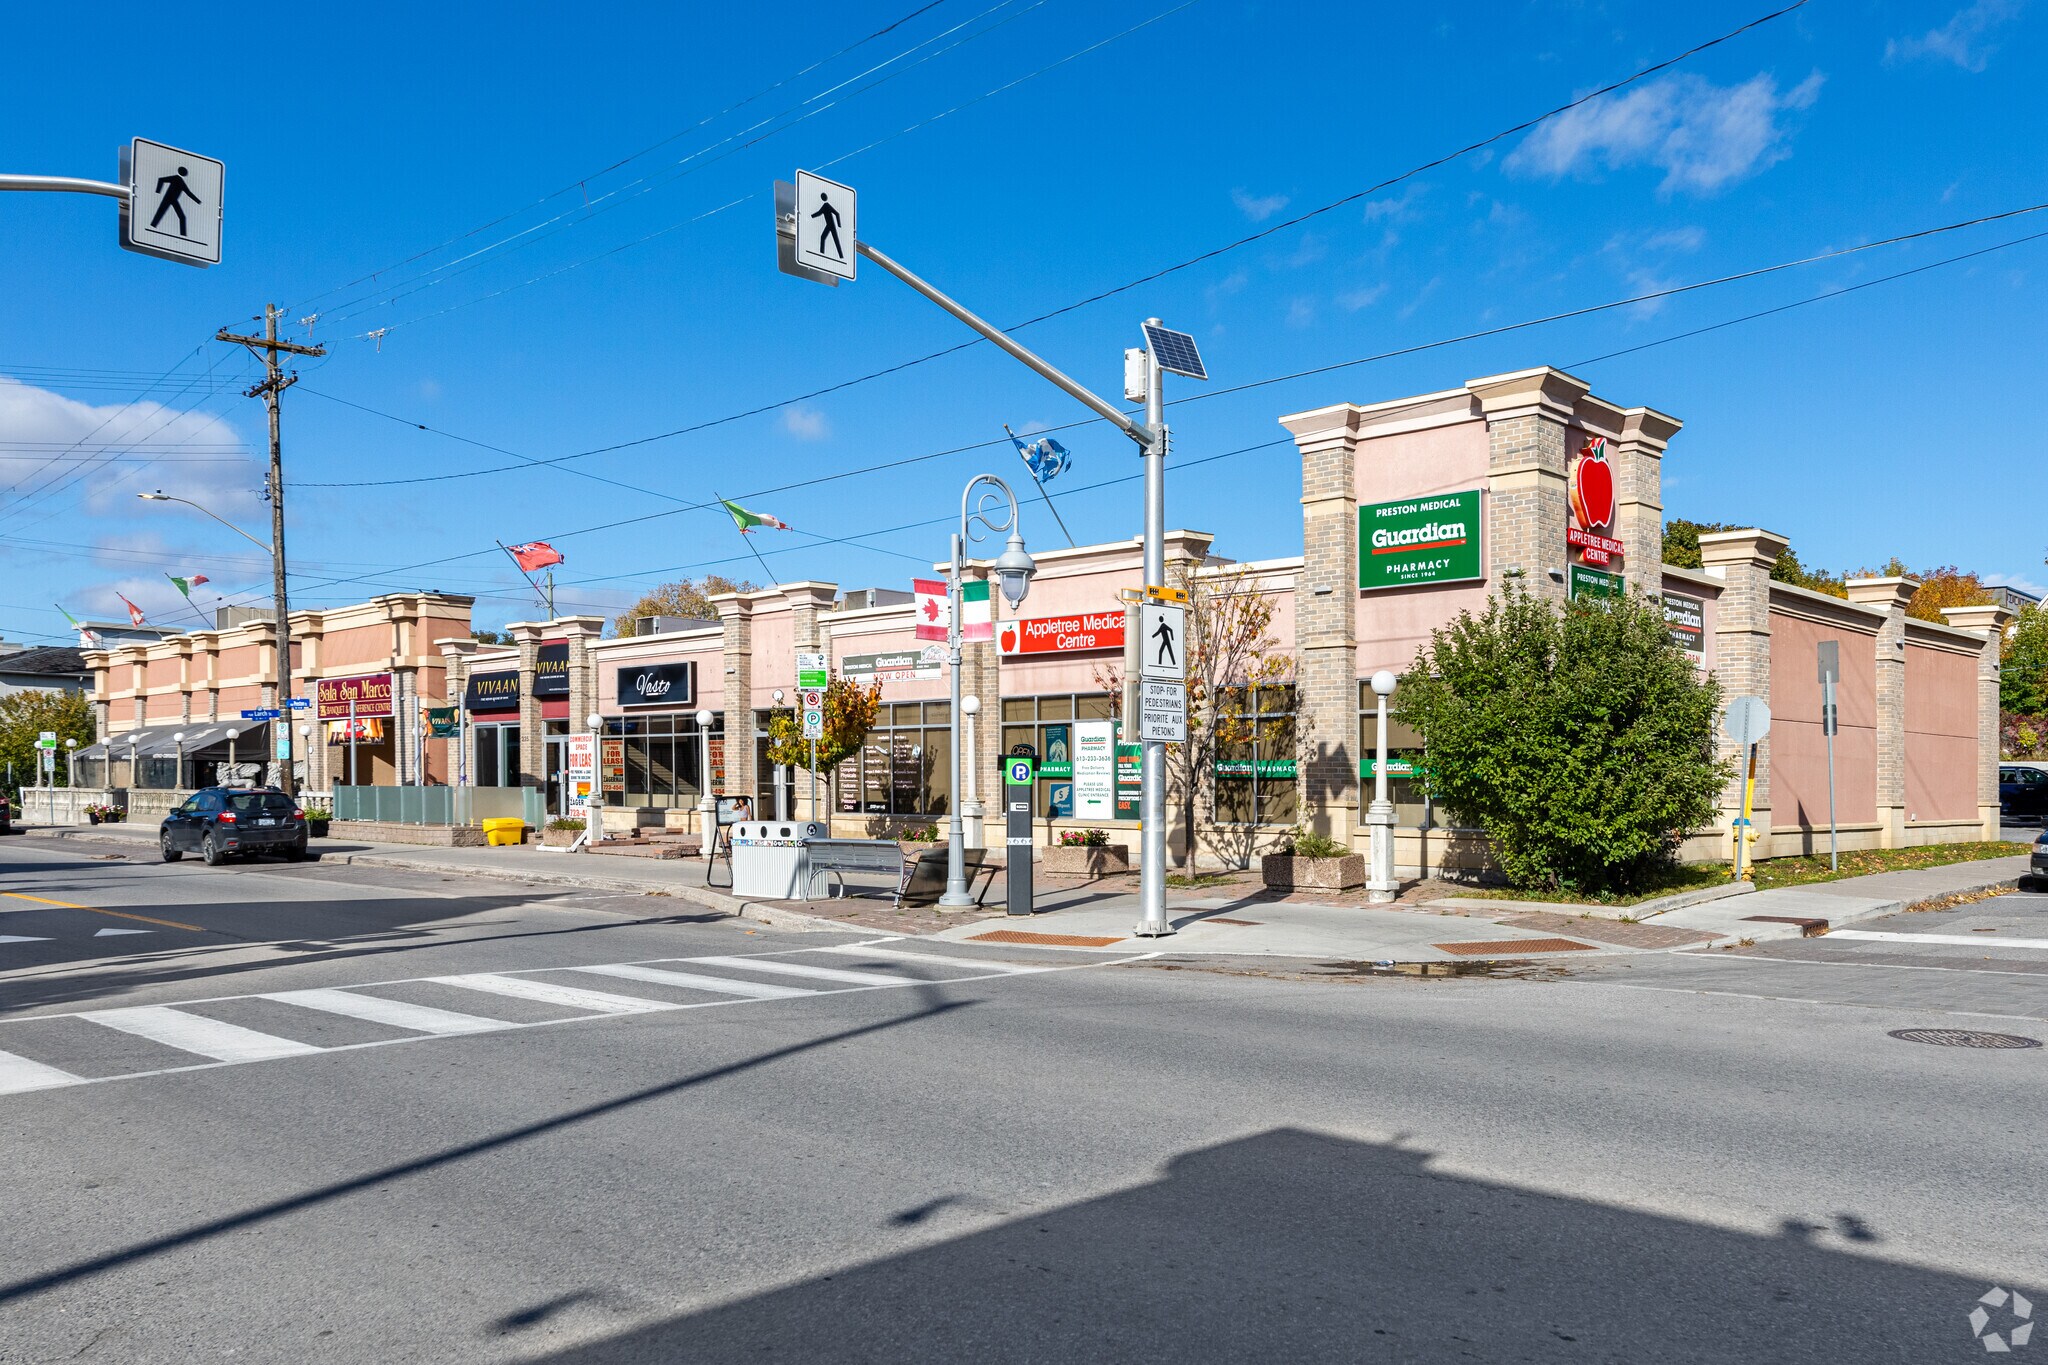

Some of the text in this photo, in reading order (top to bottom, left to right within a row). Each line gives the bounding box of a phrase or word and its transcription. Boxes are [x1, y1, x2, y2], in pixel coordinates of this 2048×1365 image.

[1376, 498, 1461, 518] PRESTON MEDICAL
[1371, 522, 1466, 547] Guardian
[1569, 530, 1624, 554] APPLETREE MEDICAL
[1586, 547, 1608, 563] CENTRE
[1386, 559, 1450, 574] PHARMACY
[1576, 573, 1619, 589] PRESTON MEDL
[1025, 614, 1126, 639] Appletree Medica
[1056, 634, 1096, 649] Centre
[875, 656, 914, 667] Guardian
[873, 671, 916, 680] NOW OPEN
[319, 680, 391, 702] Sala San Marco
[477, 678, 518, 695] VIVAAN
[636, 673, 671, 695] Vasto
[1150, 685, 1177, 696] STOP FOR
[350, 703, 375, 713] NFERENCE
[1145, 697, 1182, 709] PEDESTRIANS
[1172, 715, 1183, 724] AUX
[1012, 745, 1033, 757] OPEN
[569, 753, 592, 767] FOR LEAS
[1217, 763, 1253, 772] Guardian
